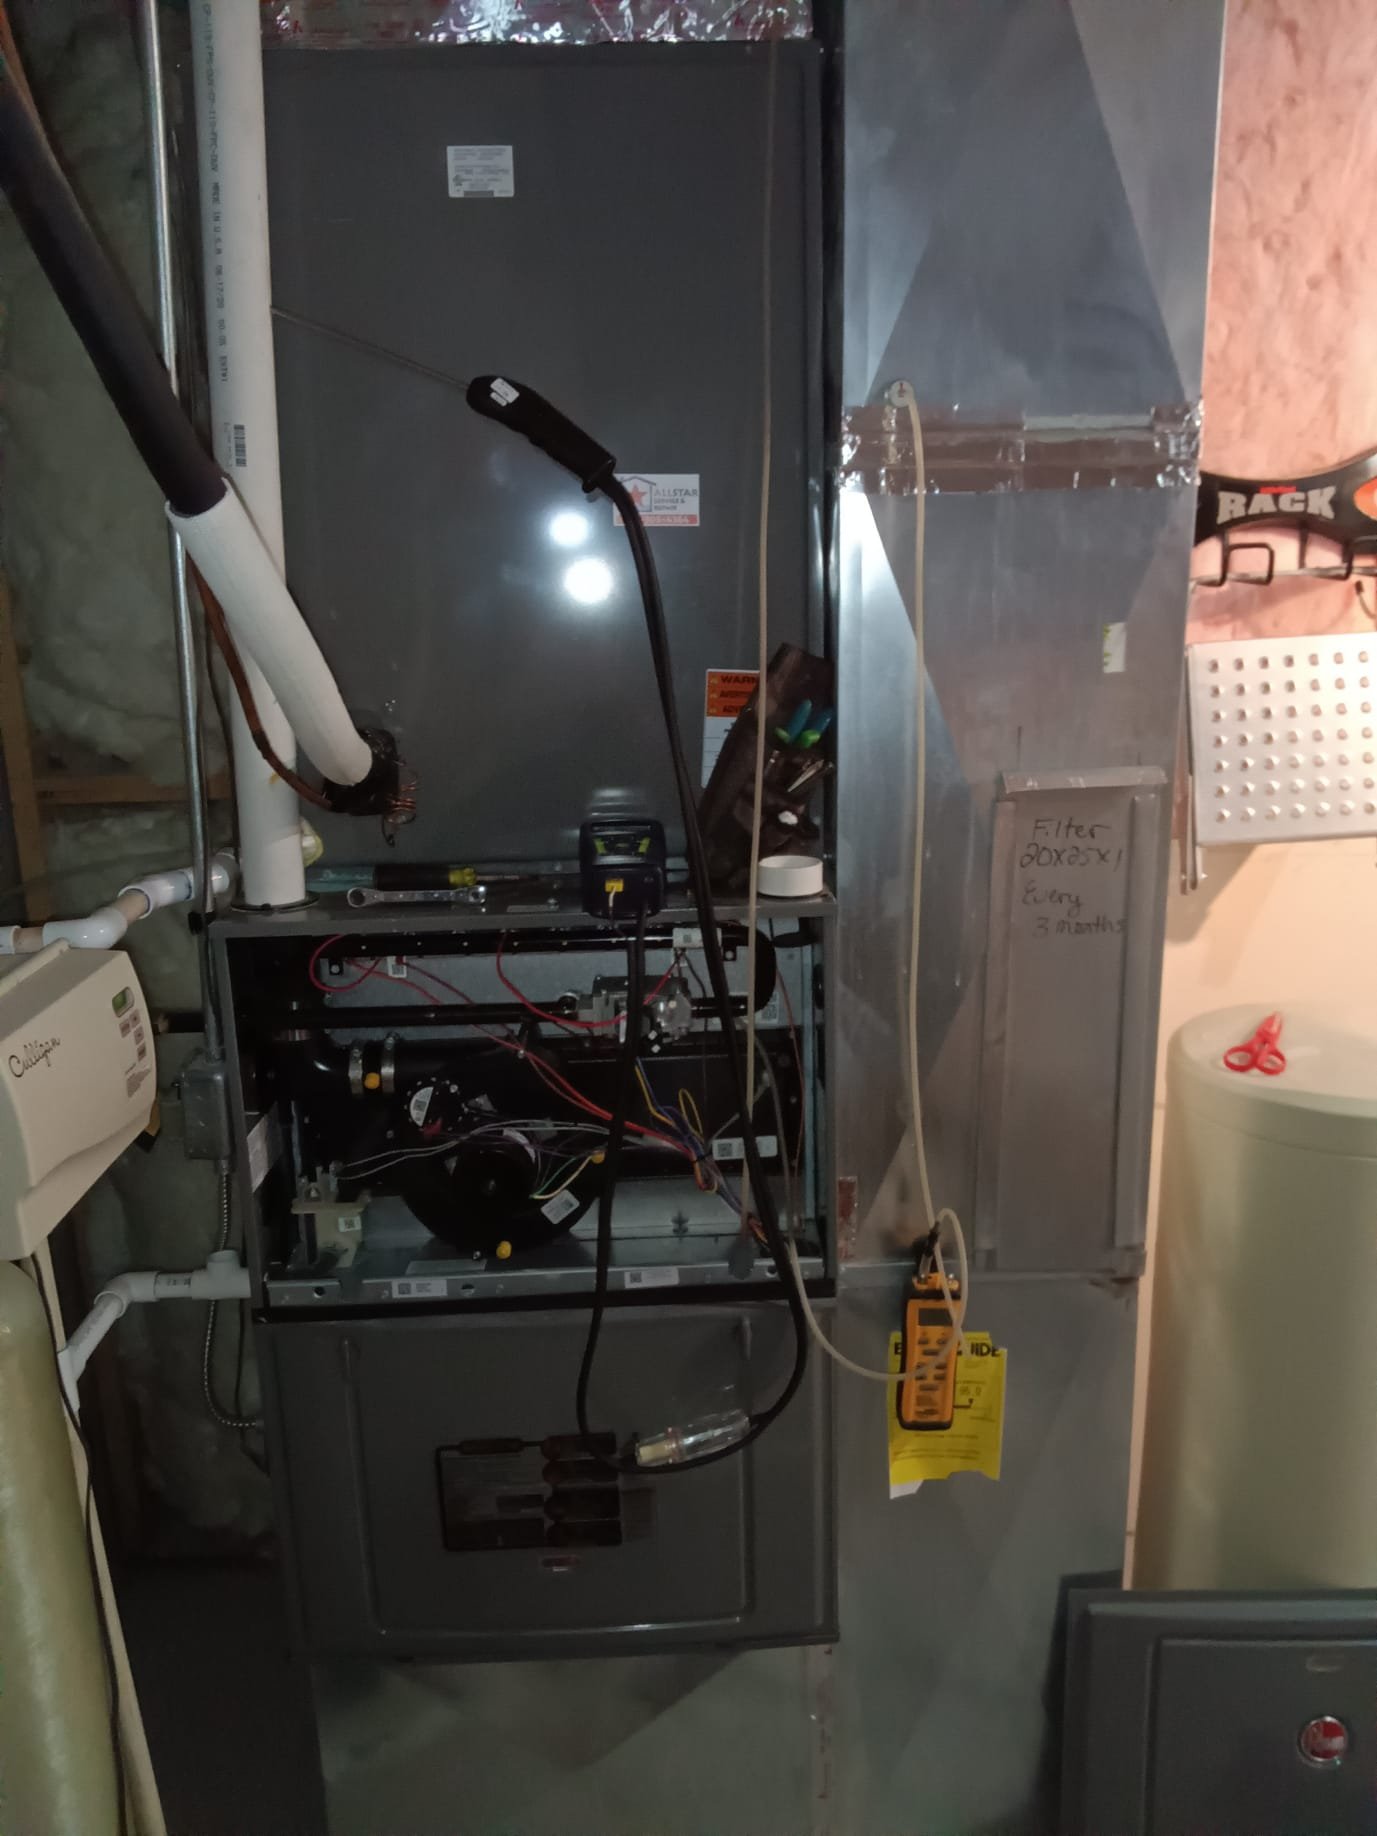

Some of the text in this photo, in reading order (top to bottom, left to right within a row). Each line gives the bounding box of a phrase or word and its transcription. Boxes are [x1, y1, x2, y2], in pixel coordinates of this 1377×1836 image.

[654, 488, 698, 497] ALLSTAR
[1216, 486, 1337, 525] RACK
[1033, 817, 1112, 841] Filter
[1021, 879, 1083, 919] Every
[1032, 914, 1126, 938] 3 months
[8, 1037, 61, 1078] Culligan
